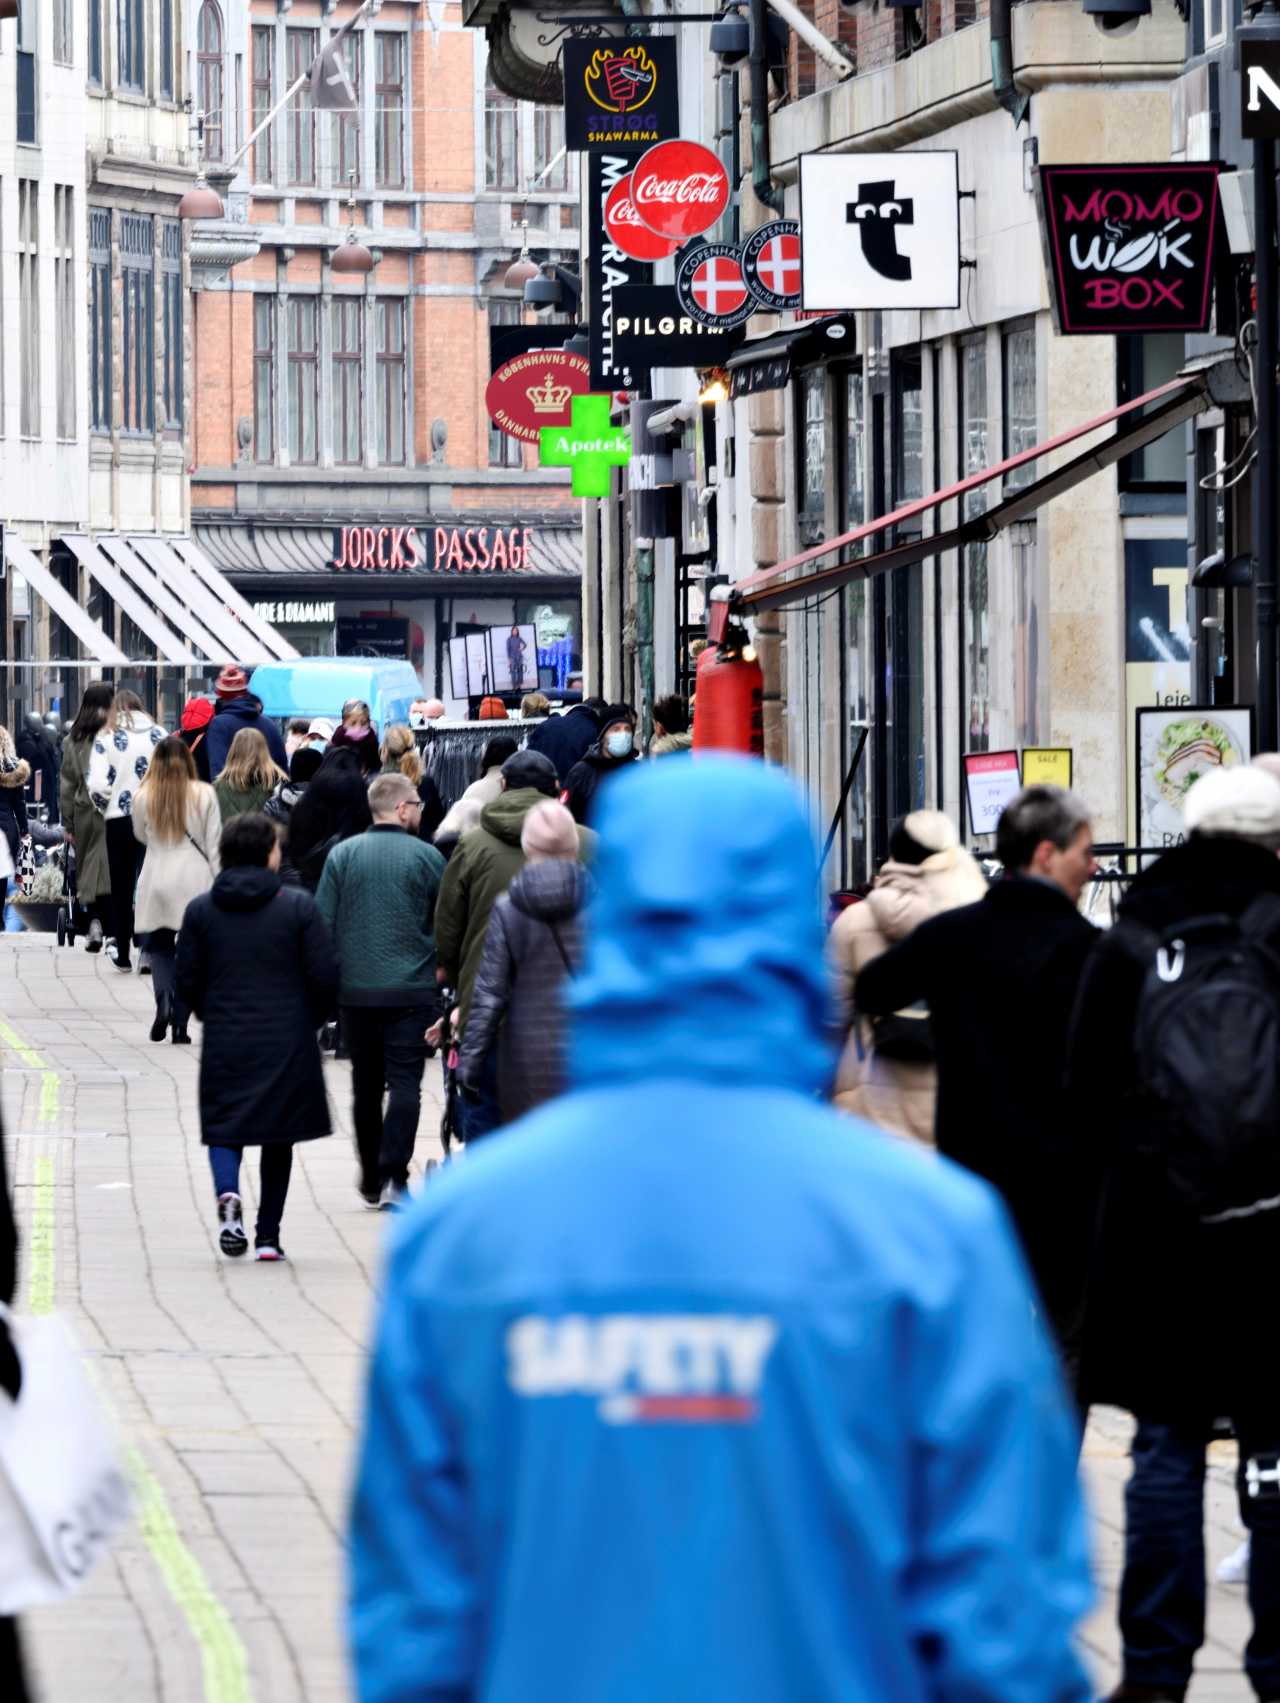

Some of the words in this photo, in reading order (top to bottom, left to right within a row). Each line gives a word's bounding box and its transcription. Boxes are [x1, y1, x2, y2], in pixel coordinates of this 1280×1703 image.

[588, 132, 658, 142] SHAWARMA
[636, 173, 724, 204] Coca-Cola
[1062, 188, 1203, 223] MOMO
[1070, 218, 1194, 273] WOK
[1084, 277, 1184, 310] BOX
[616, 317, 724, 335] PILGRI
[499, 353, 566, 383] KØBENHAVNS
[570, 356, 590, 376] BYR
[555, 436, 628, 456] Apotek
[335, 527, 417, 569] JORCKS
[434, 528, 533, 570] PASSAGE
[507, 1314, 778, 1396] SAFETY
